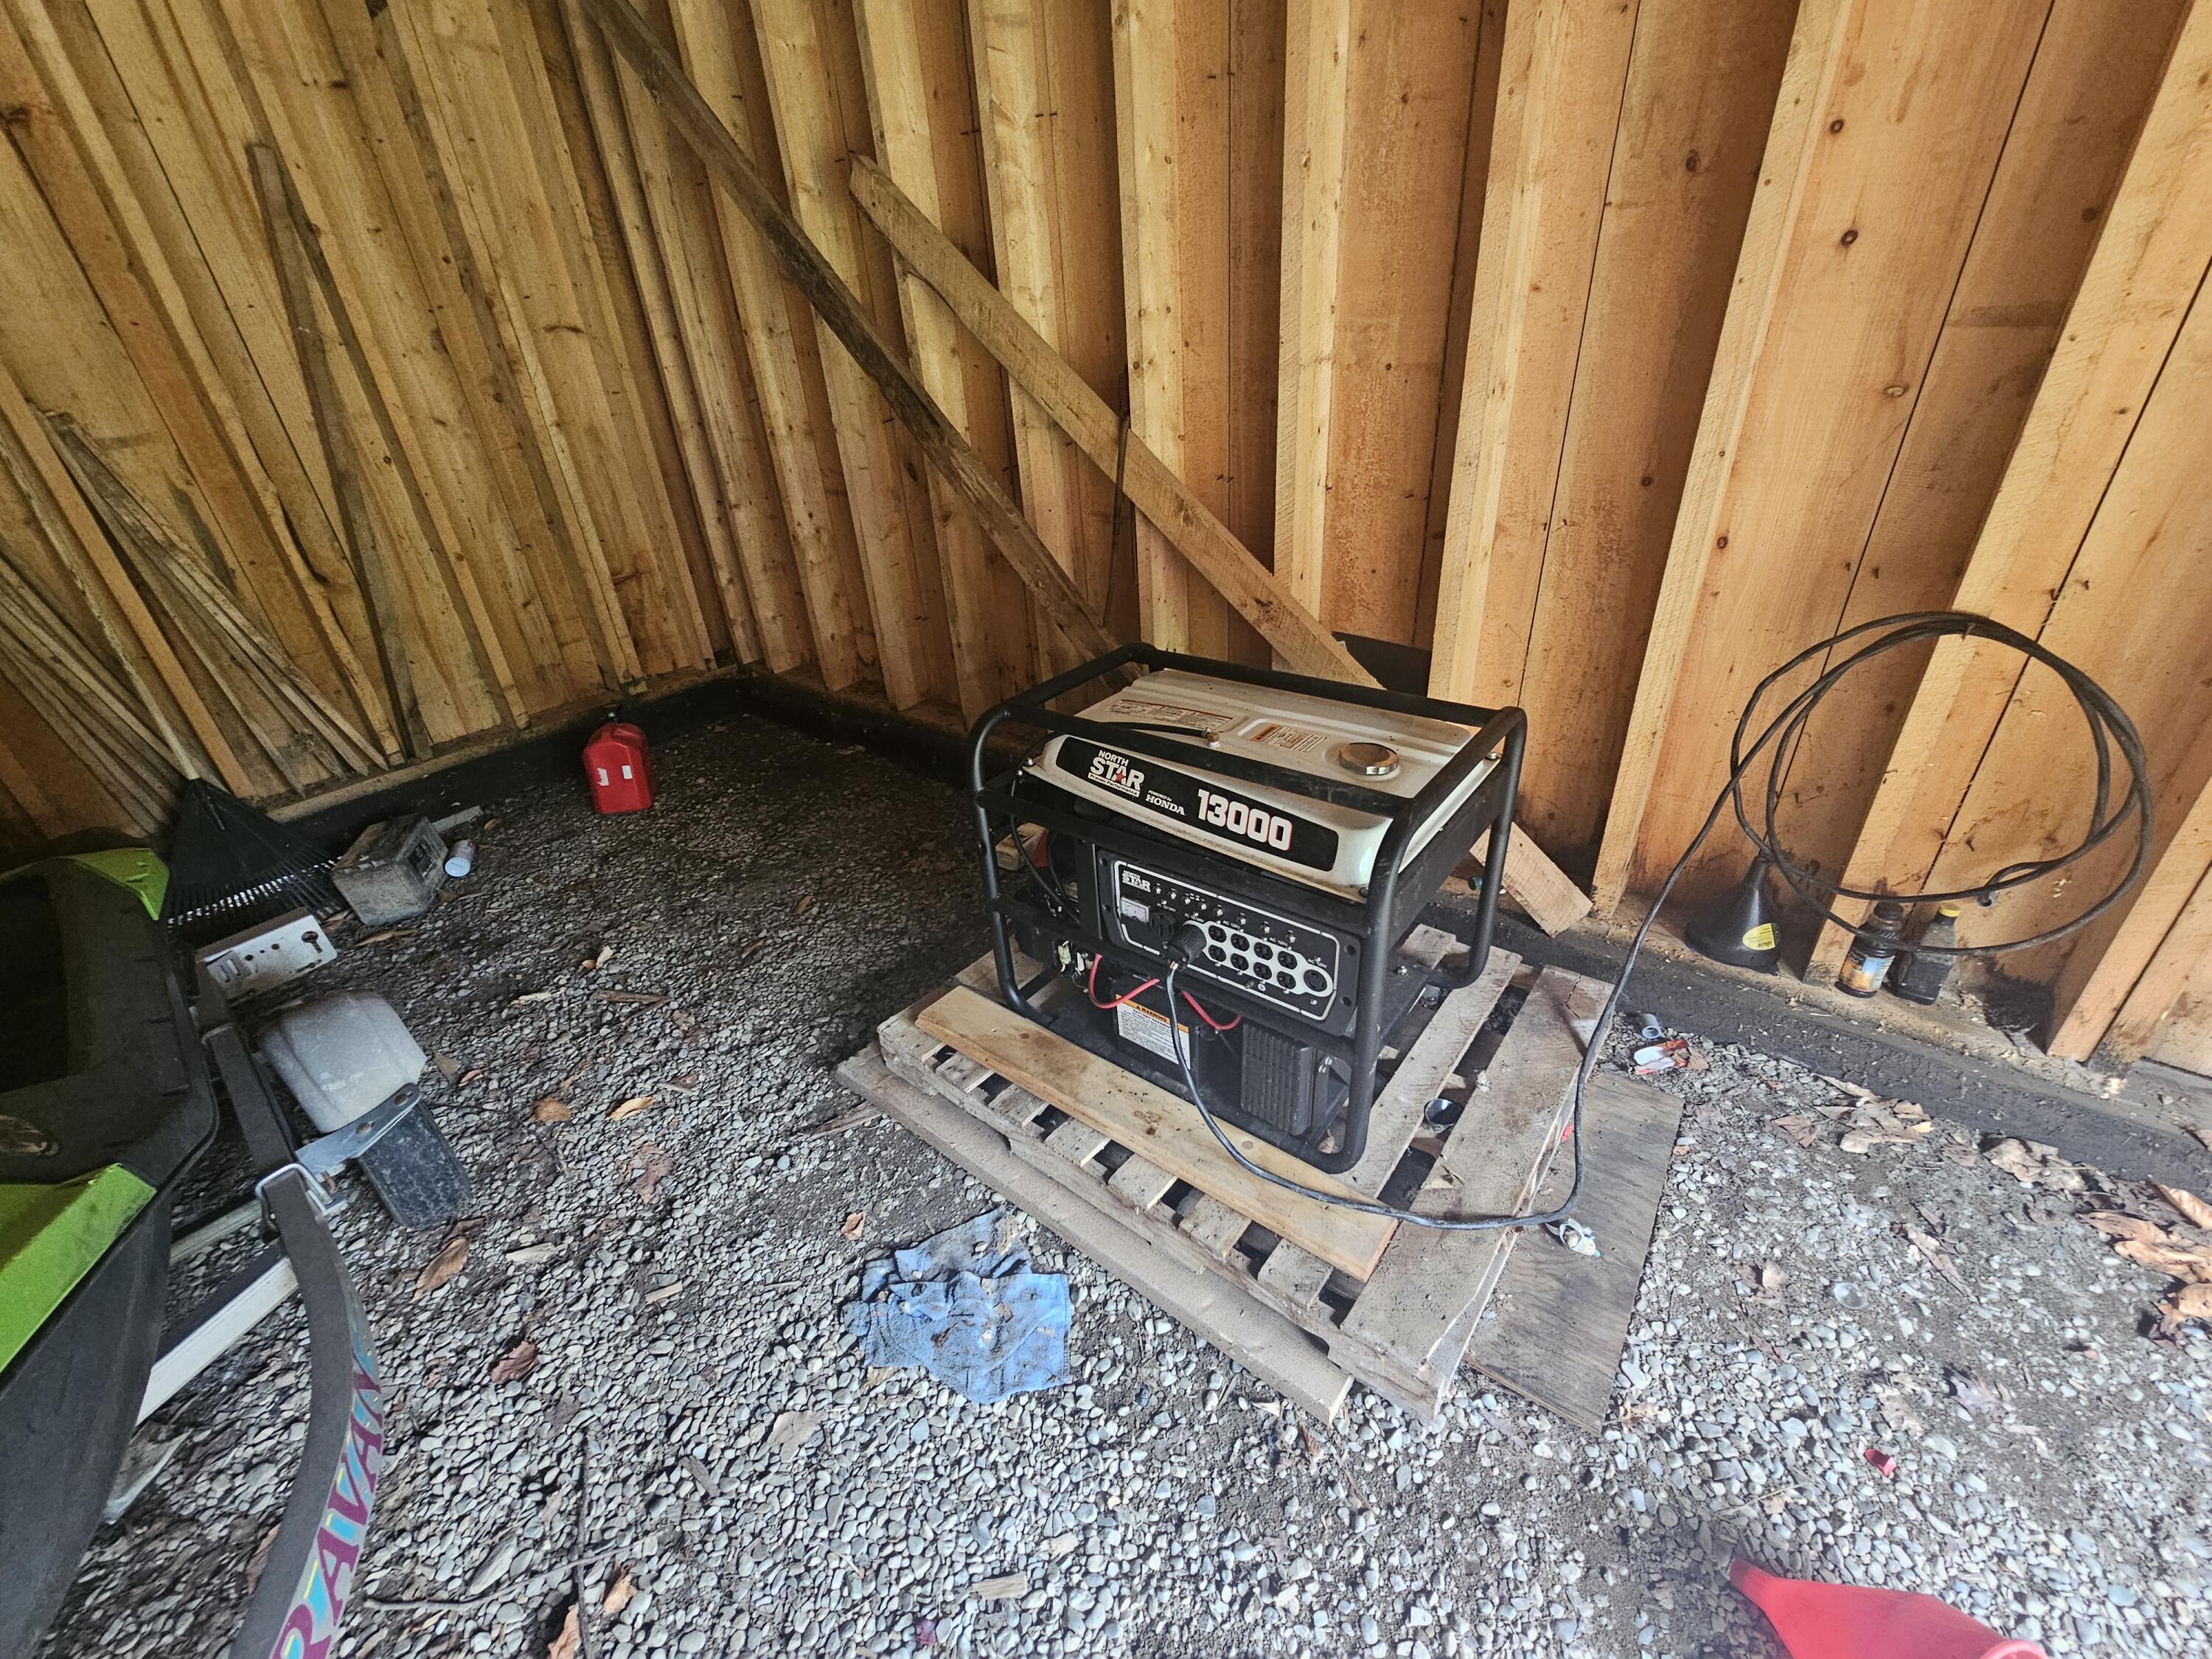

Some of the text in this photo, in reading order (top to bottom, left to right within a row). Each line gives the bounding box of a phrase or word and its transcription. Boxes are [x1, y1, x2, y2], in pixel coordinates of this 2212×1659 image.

[1099, 750, 1129, 767] NORTH
[1091, 757, 1145, 791] STAR
[1145, 794, 1185, 815] HONDA
[1197, 788, 1293, 851] 13000
[1122, 873, 1150, 891] STAR
